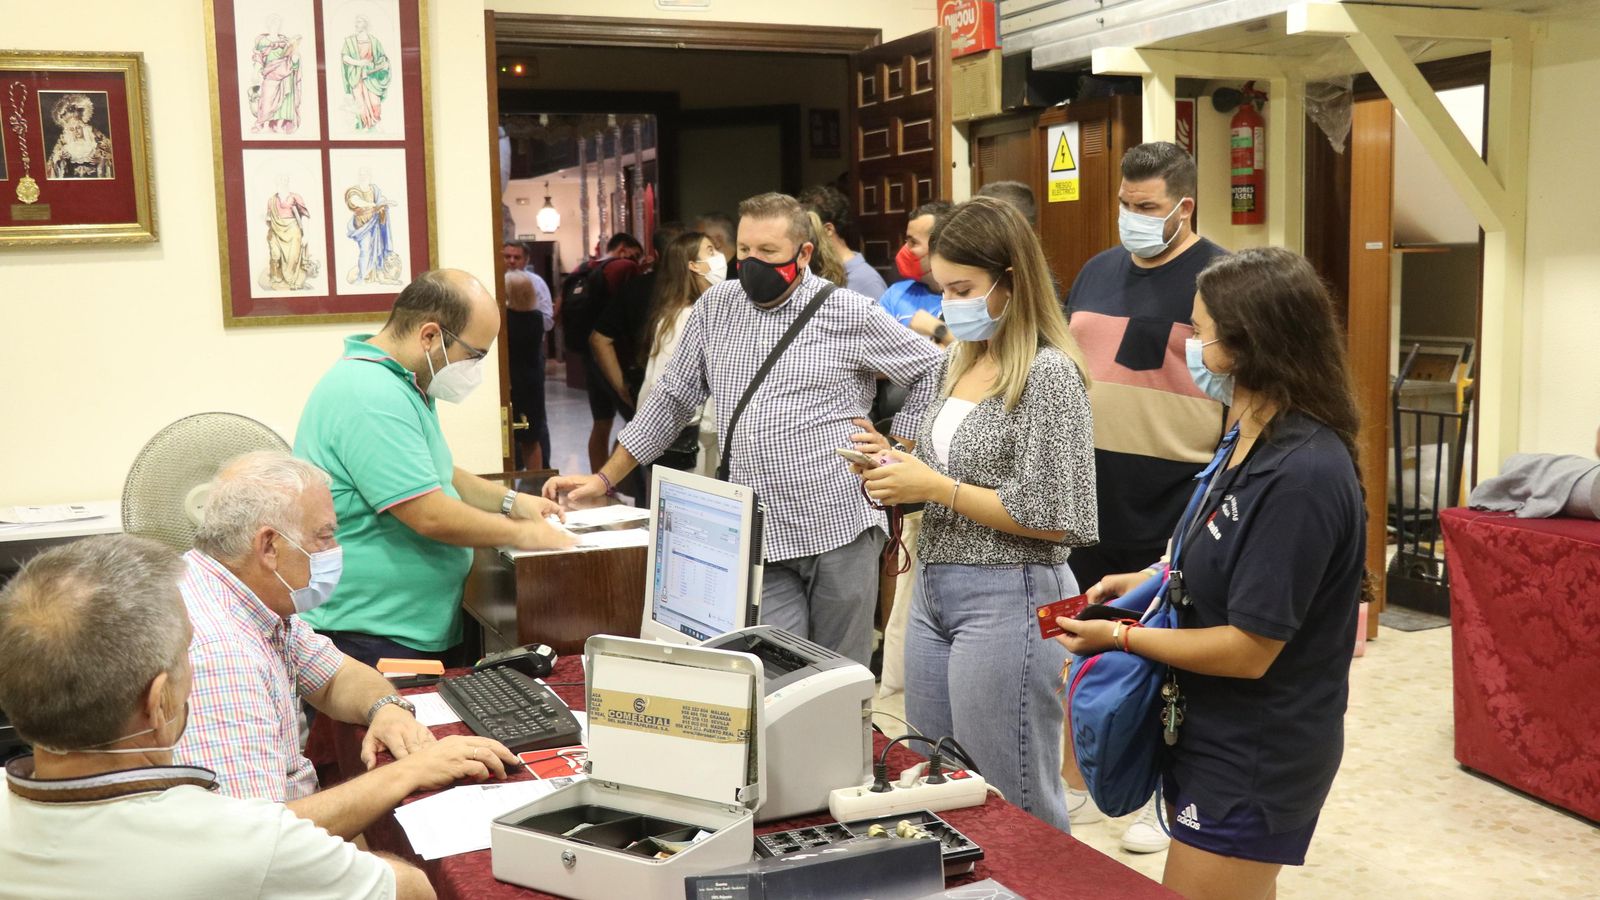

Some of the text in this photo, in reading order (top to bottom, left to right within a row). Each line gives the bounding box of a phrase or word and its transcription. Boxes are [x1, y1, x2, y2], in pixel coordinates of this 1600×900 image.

[608, 709, 670, 726] COMERCIAL
[703, 727, 721, 735] PUERTO
[1177, 814, 1201, 831] adidas
